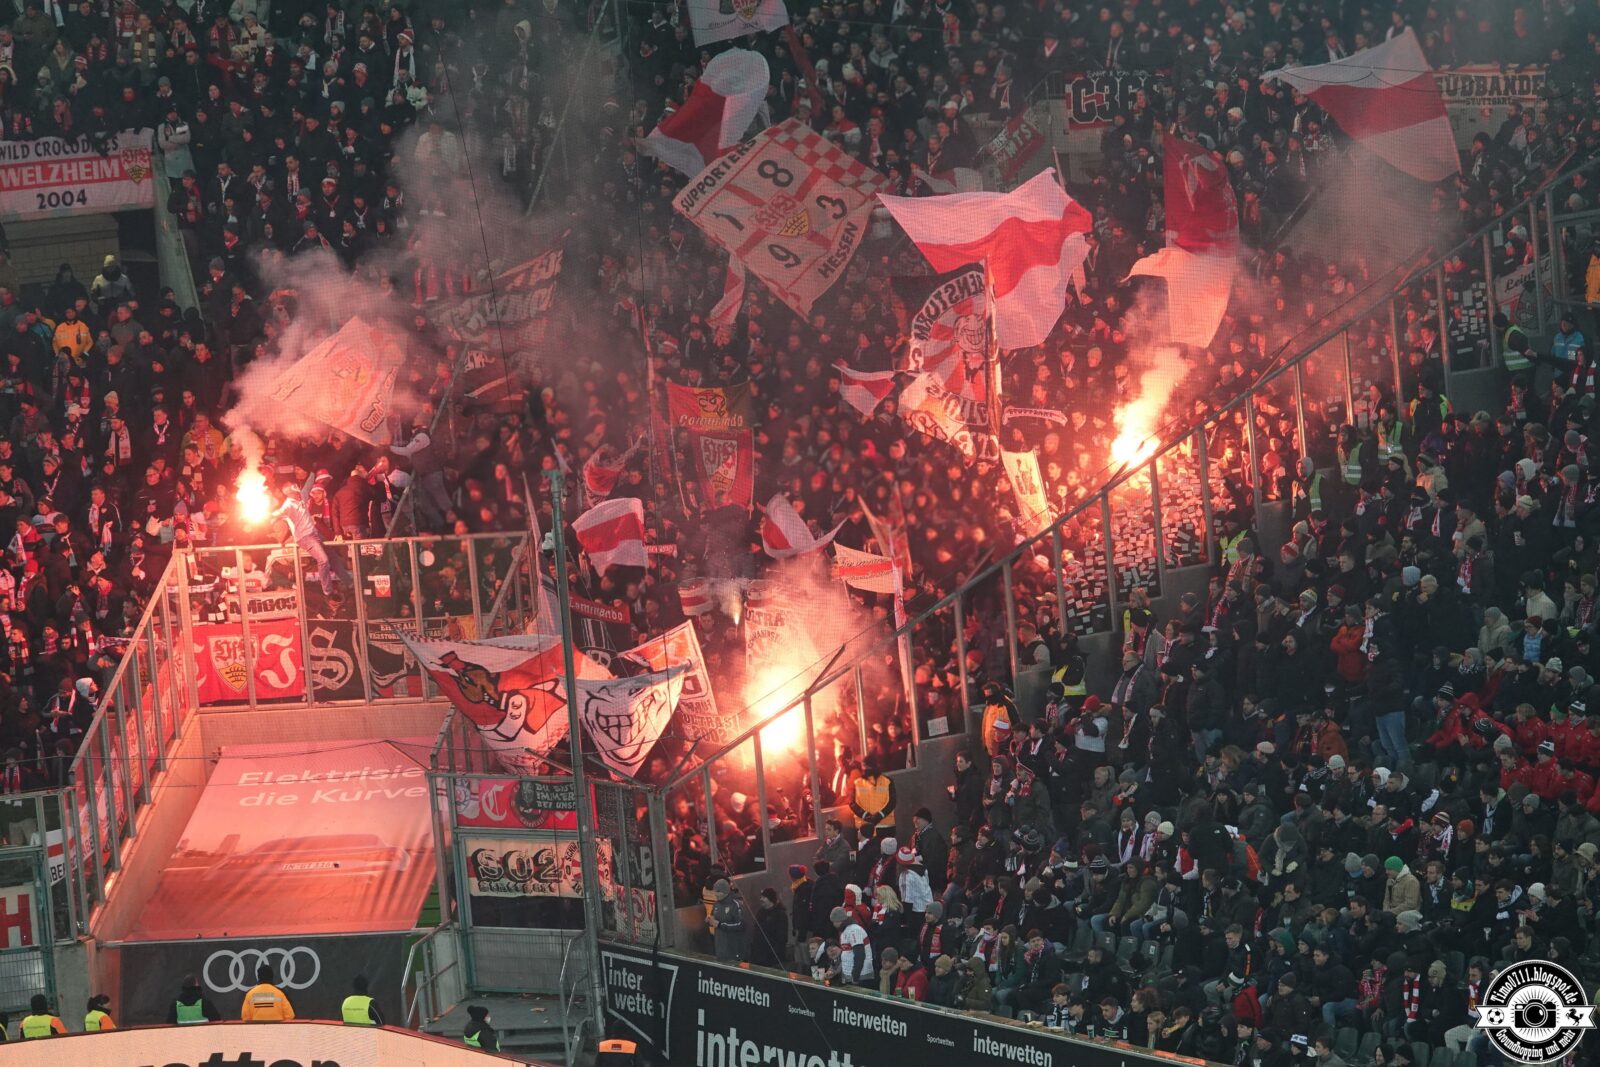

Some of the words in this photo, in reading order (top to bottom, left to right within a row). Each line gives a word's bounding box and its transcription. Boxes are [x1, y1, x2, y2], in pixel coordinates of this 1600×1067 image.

[1, 158, 121, 188] WELZHEIM
[680, 139, 757, 212] SUPPORTERS
[757, 159, 794, 188] 8
[36, 188, 88, 209] 2004
[815, 194, 848, 220] 3
[817, 221, 859, 279] HESSEN
[239, 791, 299, 807] die
[311, 786, 427, 804] Kurve
[608, 956, 643, 992] inter
[698, 970, 770, 1008] interwetten
[833, 1000, 907, 1038] interwetten
[926, 1033, 955, 1047] Sportwetten
[973, 1029, 1053, 1067] interwetten
